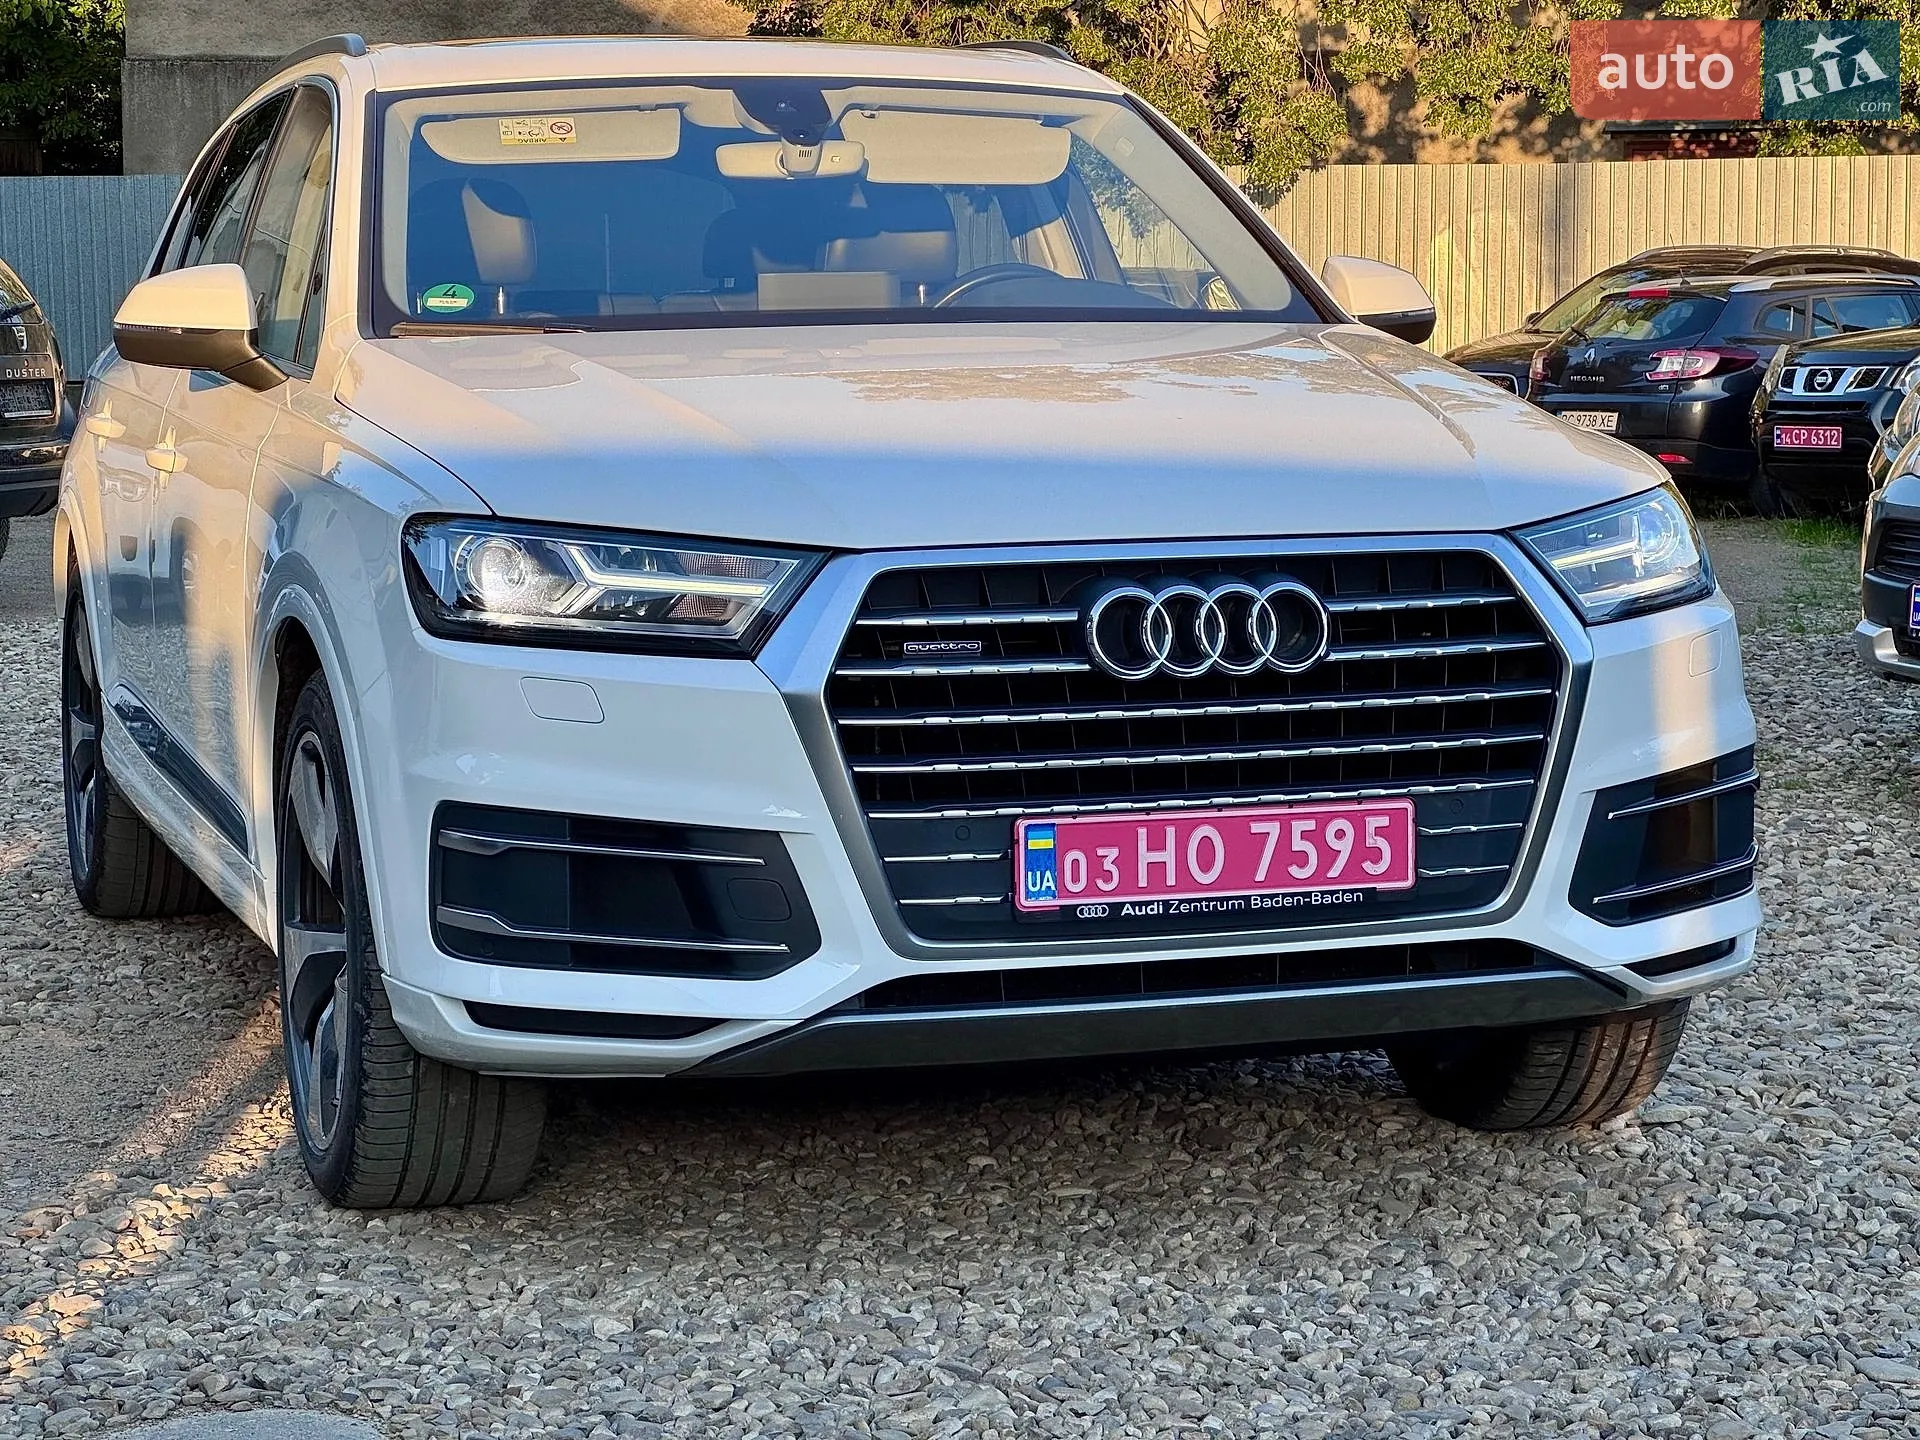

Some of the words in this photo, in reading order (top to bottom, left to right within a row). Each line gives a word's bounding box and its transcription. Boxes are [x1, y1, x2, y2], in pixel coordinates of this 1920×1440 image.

[442, 285, 457, 298] 4
[6, 368, 46, 378] DUSTER
[1576, 414, 1598, 428] 9738
[1599, 414, 1614, 428] XE
[1781, 432, 1791, 445] 14
[1792, 429, 1808, 444] CP
[1811, 430, 1838, 445] 6312
[908, 643, 978, 652] quattro
[1063, 846, 1120, 893] 03
[1137, 823, 1226, 888] HO
[1249, 815, 1393, 883] 7595
[1027, 869, 1056, 892] UA
[1121, 902, 1163, 917] Audi
[1169, 899, 1246, 914] Zentrum
[1251, 890, 1364, 909] Baden-Baden
